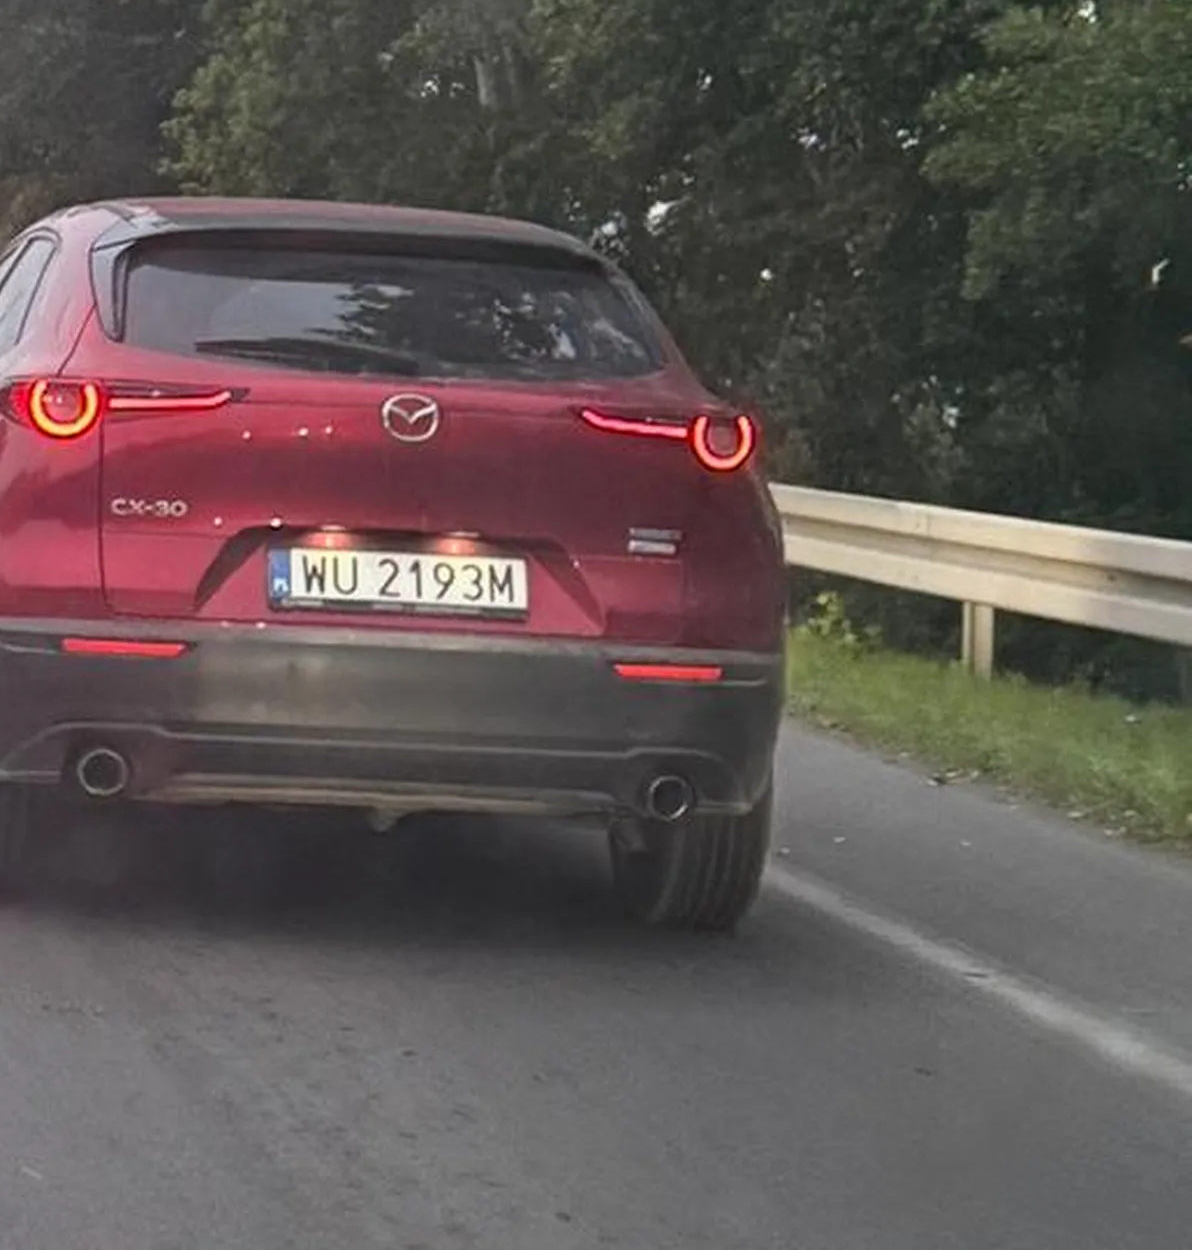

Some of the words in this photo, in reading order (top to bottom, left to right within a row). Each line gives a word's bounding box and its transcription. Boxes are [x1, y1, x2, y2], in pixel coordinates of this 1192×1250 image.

[111, 498, 188, 517] CX-30
[302, 555, 358, 595] WU
[378, 558, 515, 603] 2193M
